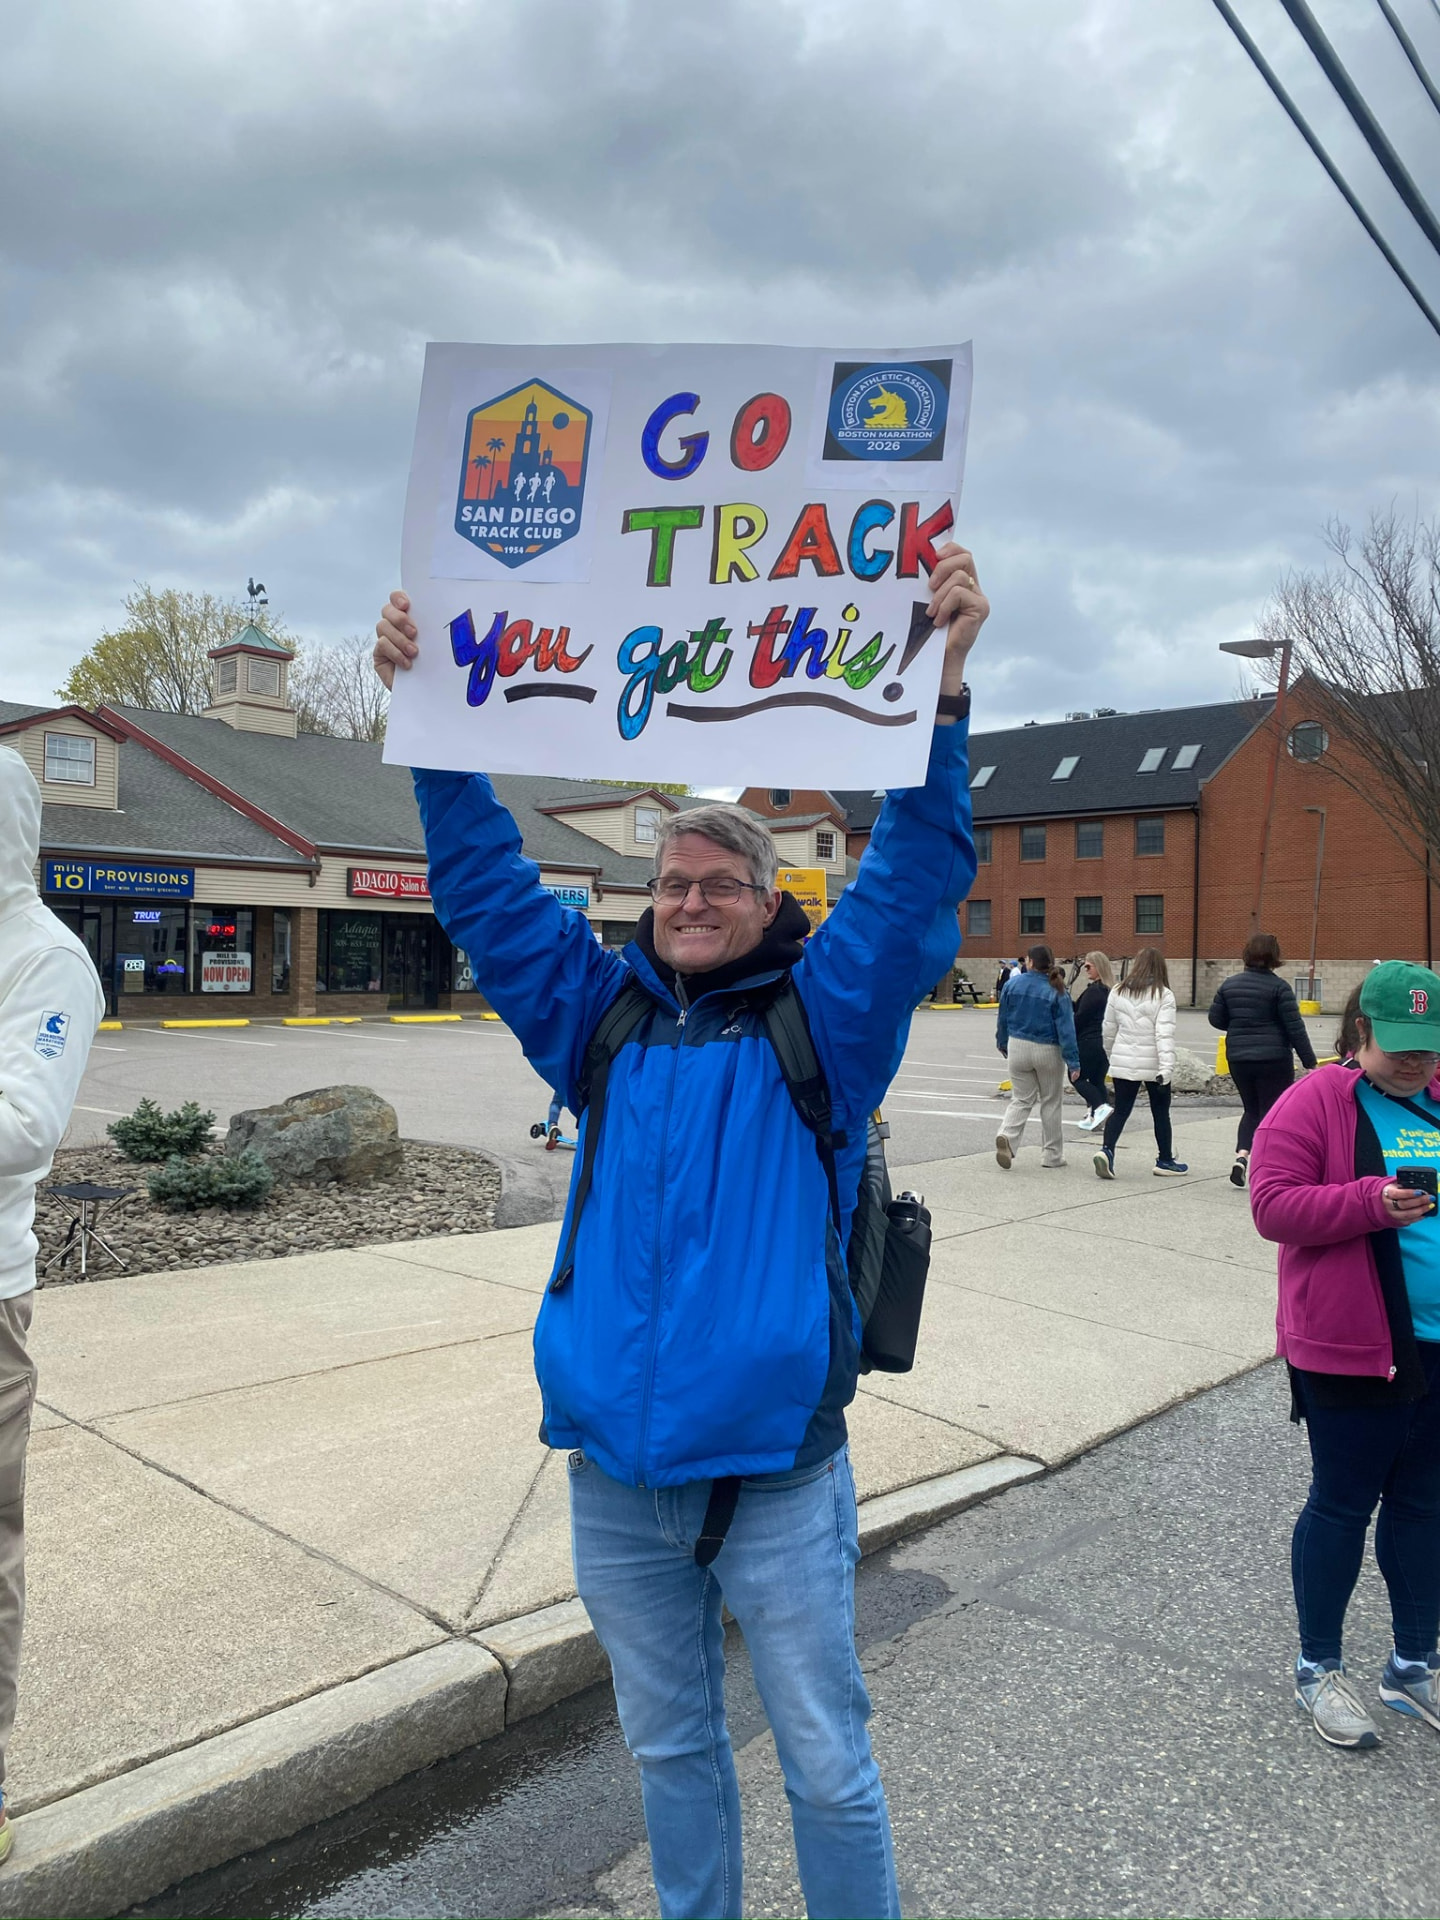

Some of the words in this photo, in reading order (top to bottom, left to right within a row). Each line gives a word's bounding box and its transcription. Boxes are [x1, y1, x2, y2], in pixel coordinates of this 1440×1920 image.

[846, 390, 860, 424] BOSTON
[860, 373, 903, 391] ATHLETIC
[904, 376, 931, 425] ASSOCIATION
[641, 391, 792, 481] GO
[838, 430, 876, 438] BOSTON
[878, 431, 932, 439] MARATHON
[867, 441, 901, 451] 2026
[461, 506, 504, 523] SAN
[510, 507, 576, 524] DIEGO
[470, 525, 521, 538] TRACK
[523, 527, 563, 539] CLUB
[504, 546, 524, 554] 1954
[621, 498, 954, 588] TRACK
[616, 617, 734, 741] got
[54, 864, 84, 873] mile
[54, 874, 84, 889] 10
[96, 869, 189, 886] PROVISIONS
[353, 871, 398, 890] ADAGIO
[400, 878, 420, 892] Salon
[420, 880, 426, 892] &
[547, 888, 585, 901] NERS
[134, 911, 161, 919] TRULY
[340, 921, 378, 939] Adagio
[203, 966, 224, 982] NOW
[226, 966, 250, 983] OPEN!
[1409, 989, 1429, 1015] B
